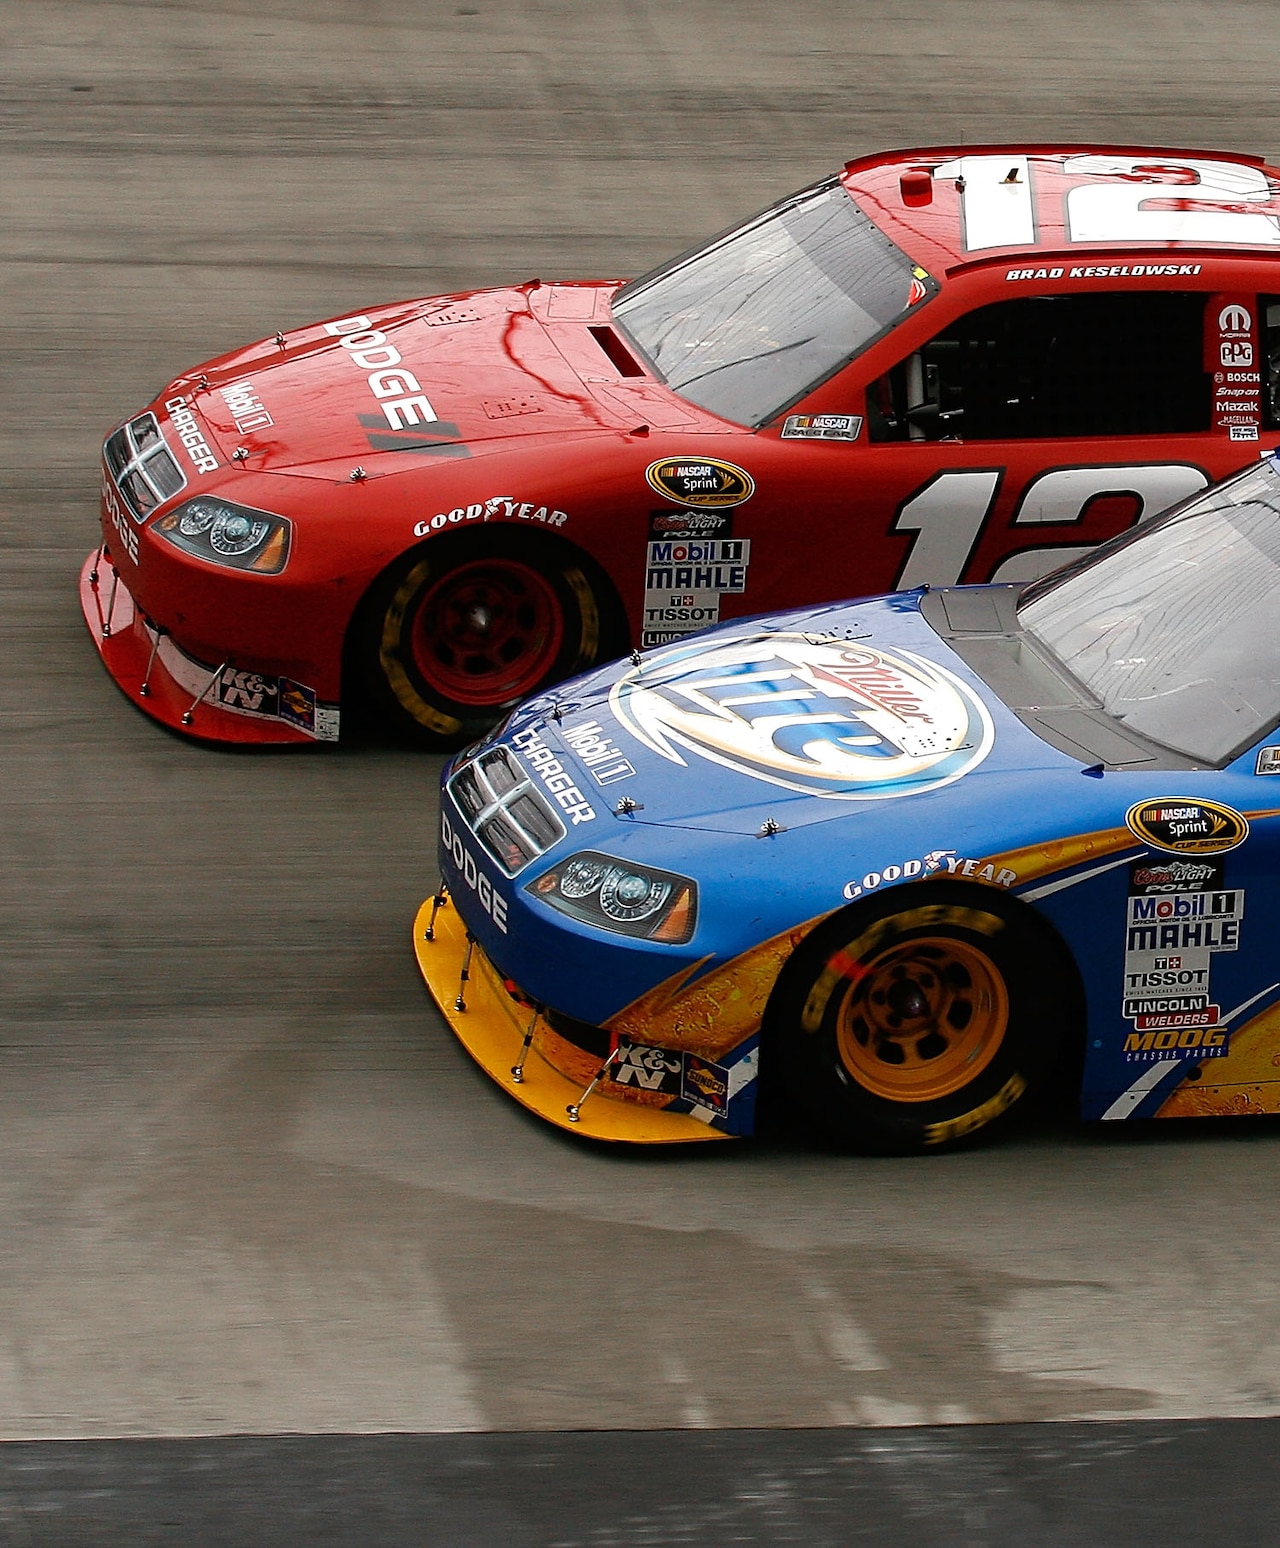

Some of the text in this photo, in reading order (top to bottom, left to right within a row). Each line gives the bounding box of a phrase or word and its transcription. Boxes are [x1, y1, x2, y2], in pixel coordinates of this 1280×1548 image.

[1006, 264, 1202, 281] BRAD KESELOWSKI
[1221, 342, 1252, 364] PPG
[323, 314, 438, 431] DODGE
[1227, 373, 1260, 382] BOSCH
[219, 381, 266, 418] Mobil
[1216, 402, 1259, 411] Mazak
[812, 418, 848, 429] NASCAR
[165, 397, 219, 475] CHARGER
[677, 466, 712, 477] NASCAR
[684, 478, 718, 492] Sprint
[688, 518, 727, 529] LIGHT
[652, 542, 715, 561] Mobil
[647, 566, 744, 589] MAHLE
[646, 608, 718, 621] TISSOT
[824, 649, 935, 726] Miller
[632, 653, 906, 765] Lite
[561, 720, 623, 767] Mobil
[512, 728, 596, 826] CHARGER
[1161, 808, 1200, 821] NASCAR
[1168, 820, 1208, 837] Sprint
[1198, 839, 1234, 848] SERIES
[441, 811, 509, 935] DODGE
[1174, 868, 1217, 881] LIGHT
[1145, 882, 1204, 892] POLE
[1134, 895, 1205, 919] Mobil
[1128, 921, 1238, 951] MAHLE
[1127, 970, 1208, 987] TISSOT
[1129, 998, 1203, 1014] LINCOLN
[1145, 1013, 1209, 1027] WELDERS
[1123, 1028, 1228, 1051] MOOG
[1126, 1048, 1223, 1062] CHASSIS PARTS
[689, 1070, 724, 1093] SUNOCO
